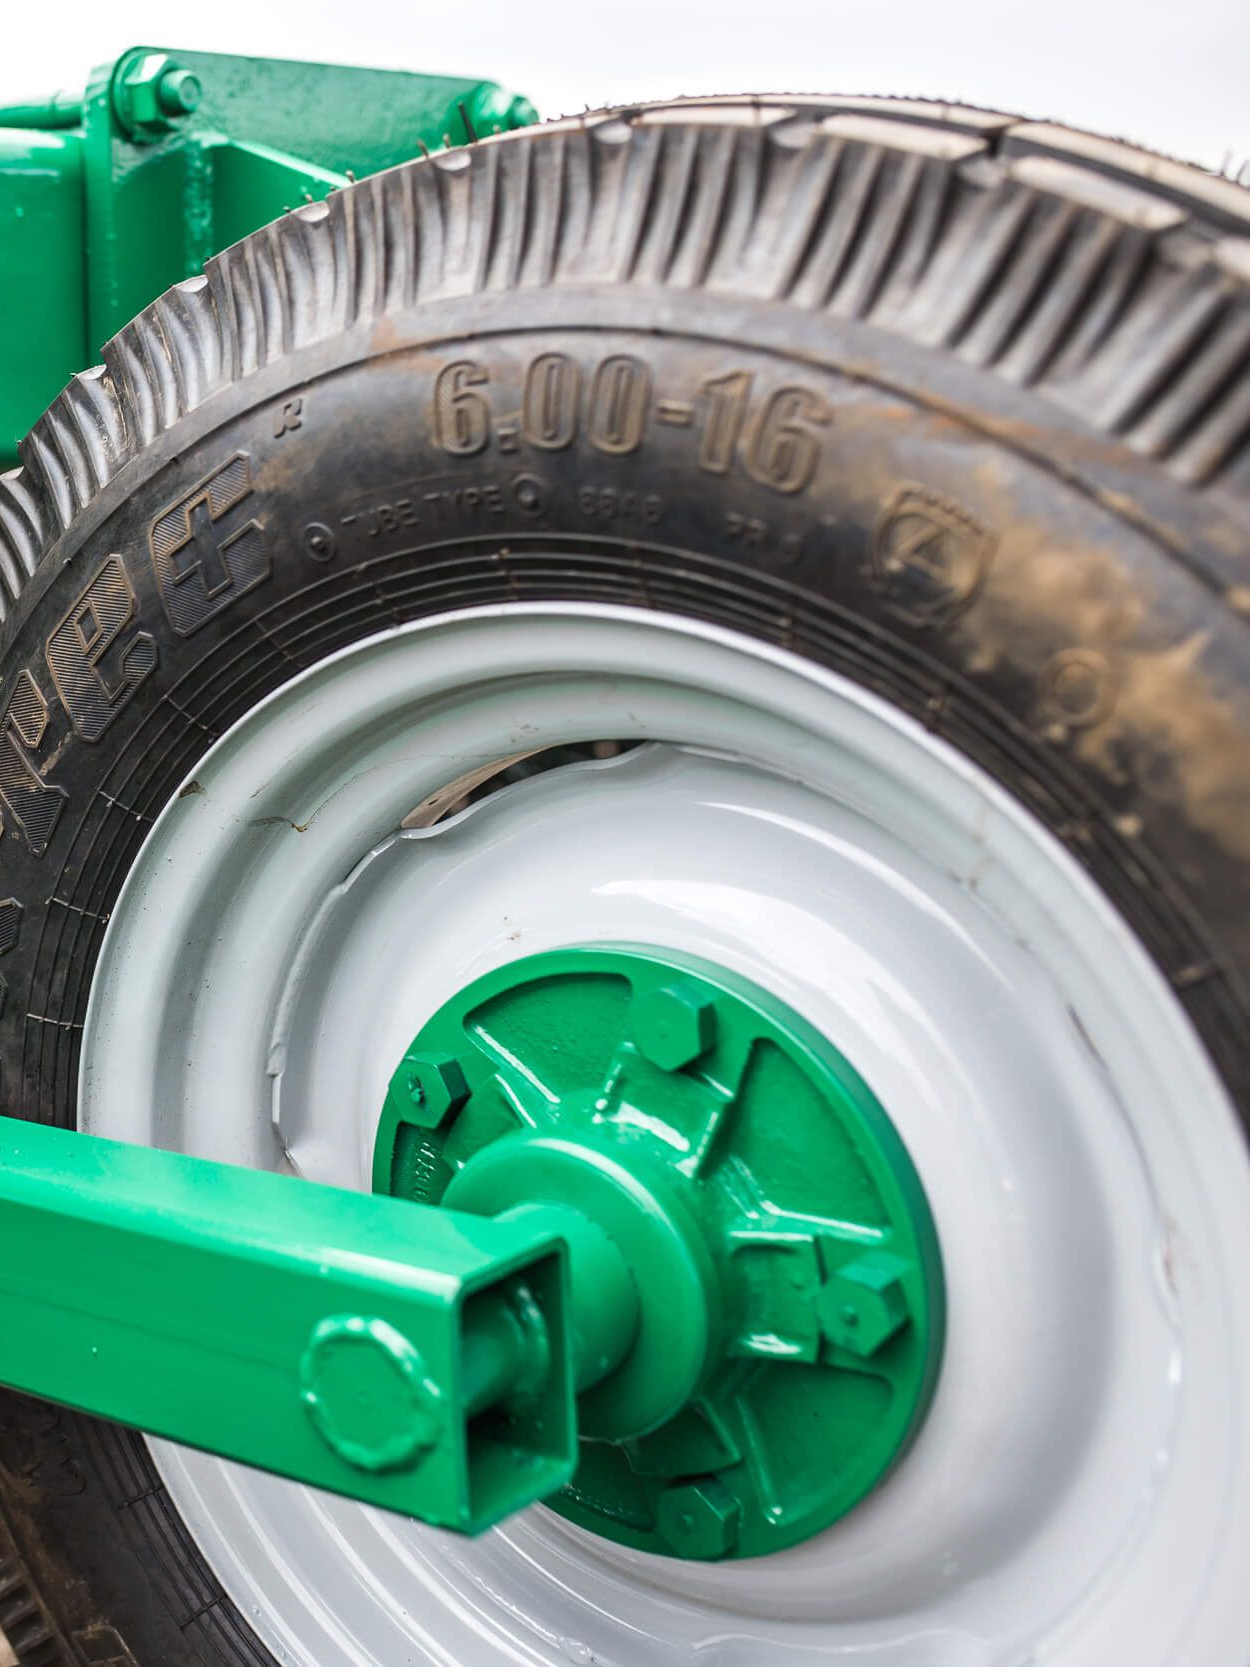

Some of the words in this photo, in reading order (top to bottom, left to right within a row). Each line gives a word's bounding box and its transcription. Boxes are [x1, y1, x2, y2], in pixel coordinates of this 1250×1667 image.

[432, 352, 834, 494] 6.00-16
[341, 498, 419, 536] TUBE
[422, 484, 506, 521] TYPE
